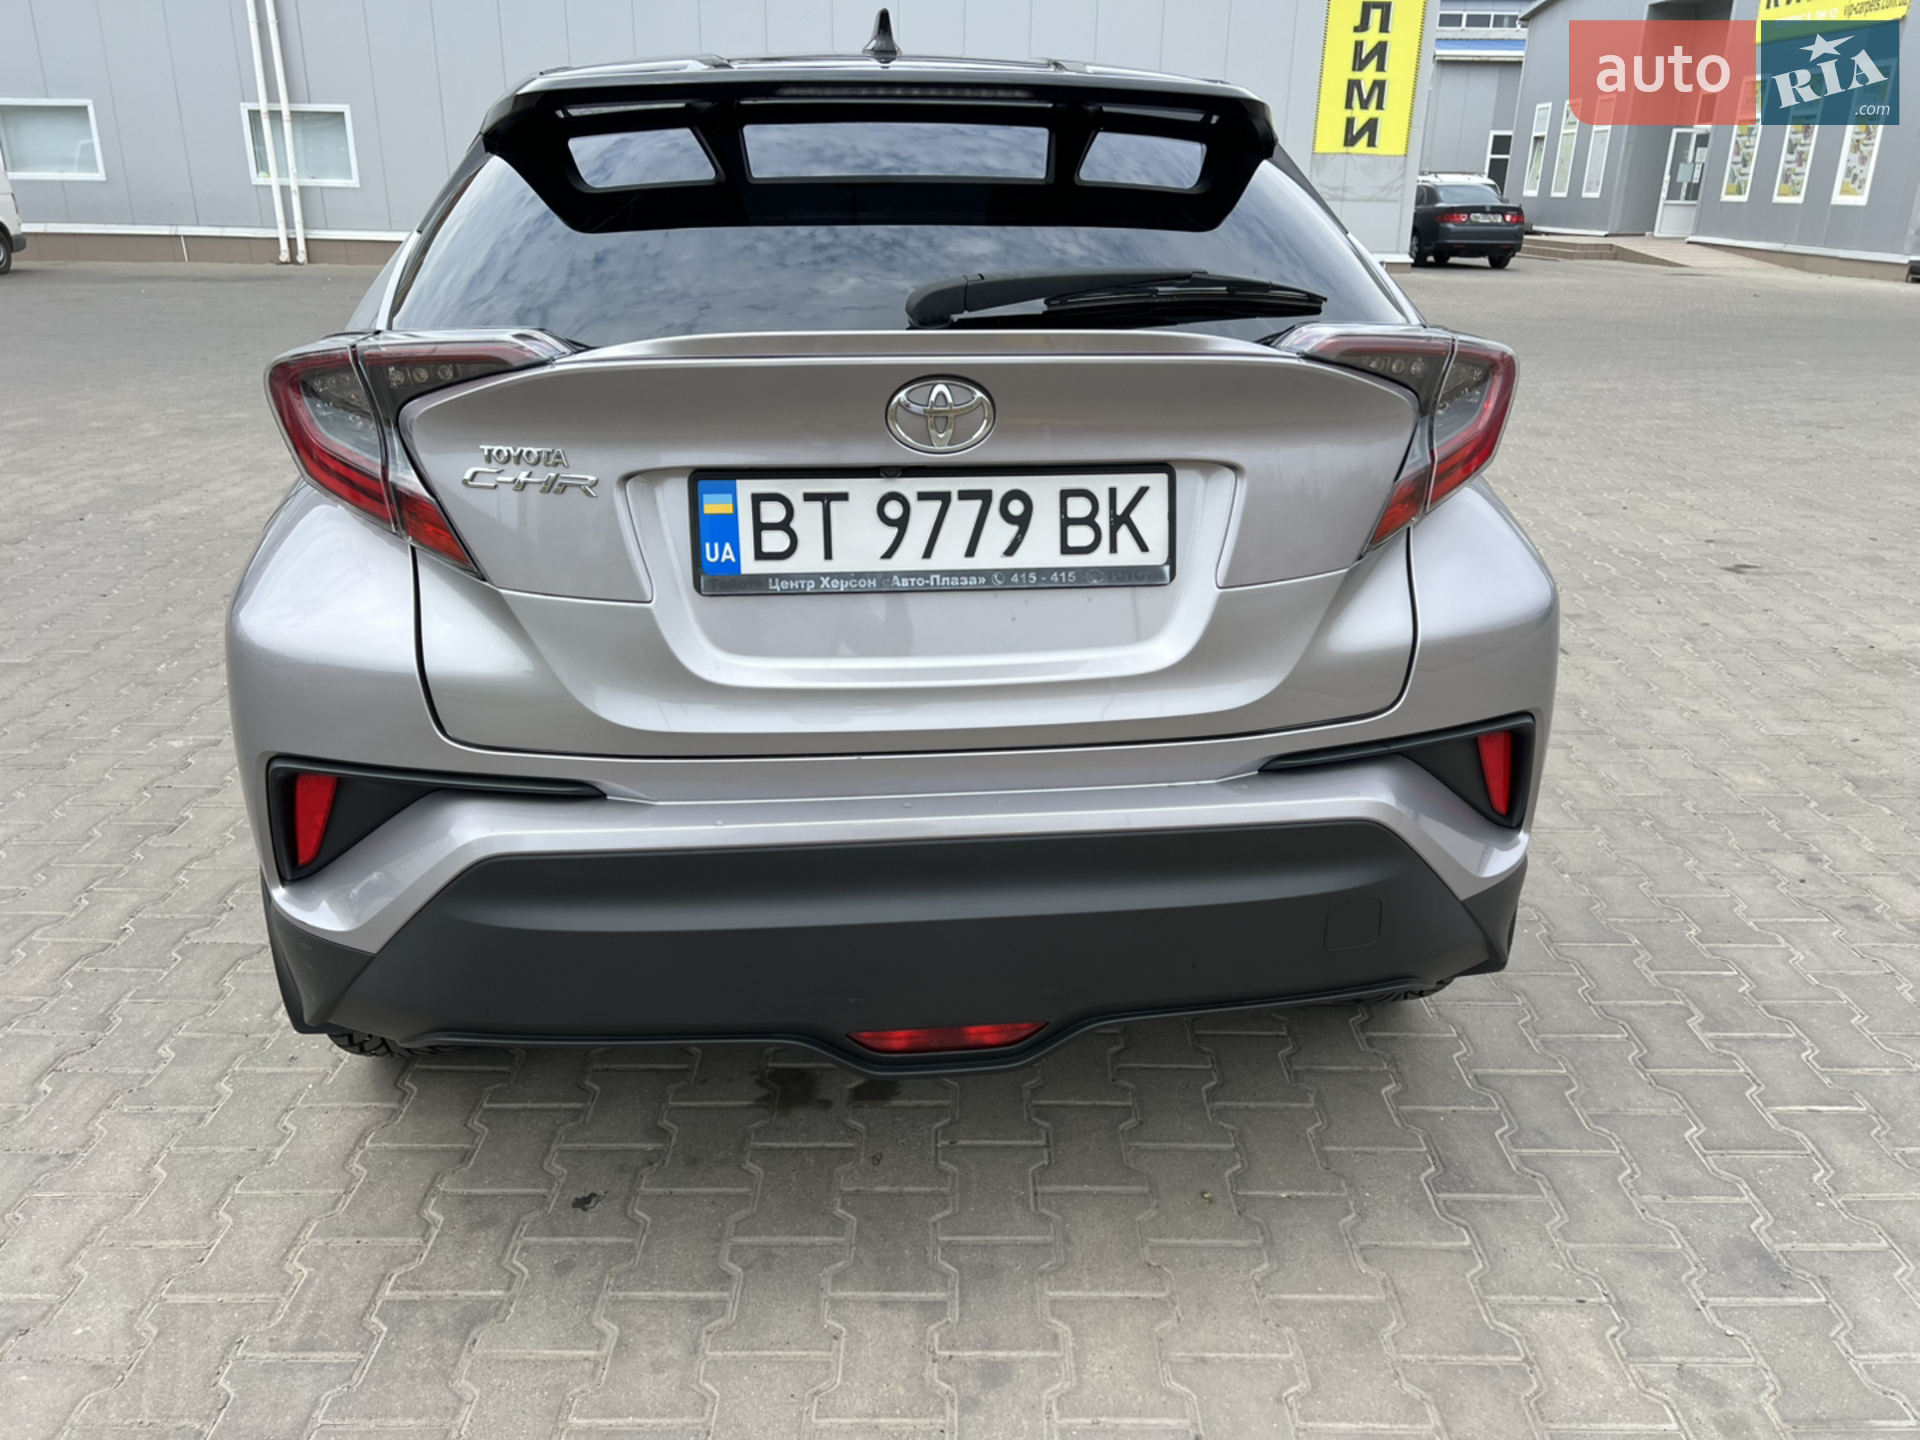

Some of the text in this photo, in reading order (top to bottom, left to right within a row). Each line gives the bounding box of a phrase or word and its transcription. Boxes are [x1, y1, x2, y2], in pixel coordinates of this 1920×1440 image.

[479, 445, 569, 468] TOYOTA
[462, 467, 598, 498] C-HR
[751, 486, 1151, 561] BT 9779 BK
[705, 542, 736, 563] UA
[768, 577, 815, 591] Центр
[820, 575, 877, 591] Херсон
[1010, 571, 1037, 584] 415
[1050, 570, 1077, 583] 415
